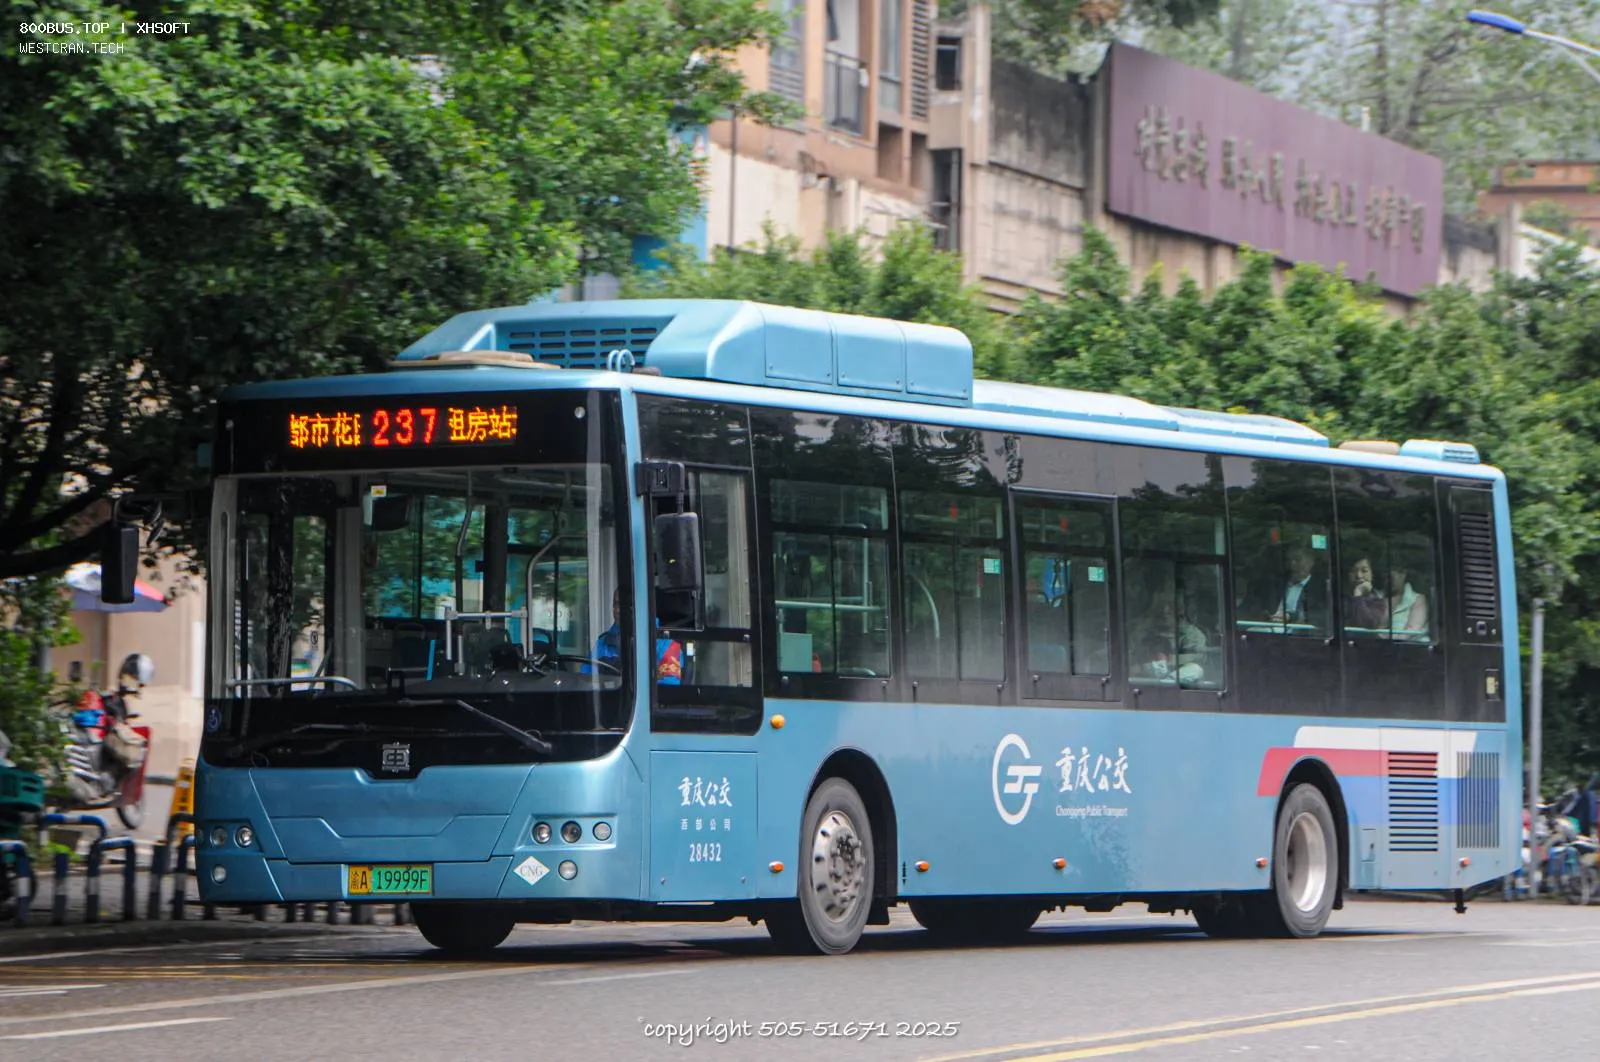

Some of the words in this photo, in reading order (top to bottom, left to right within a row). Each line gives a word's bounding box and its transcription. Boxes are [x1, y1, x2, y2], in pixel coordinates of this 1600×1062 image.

[289, 412, 361, 449] 都市花
[372, 408, 437, 446] 237
[1055, 746, 1132, 794] 重庆公交
[678, 776, 732, 807] 重庆公交
[689, 843, 722, 862] 28432
[520, 865, 545, 876] CNG
